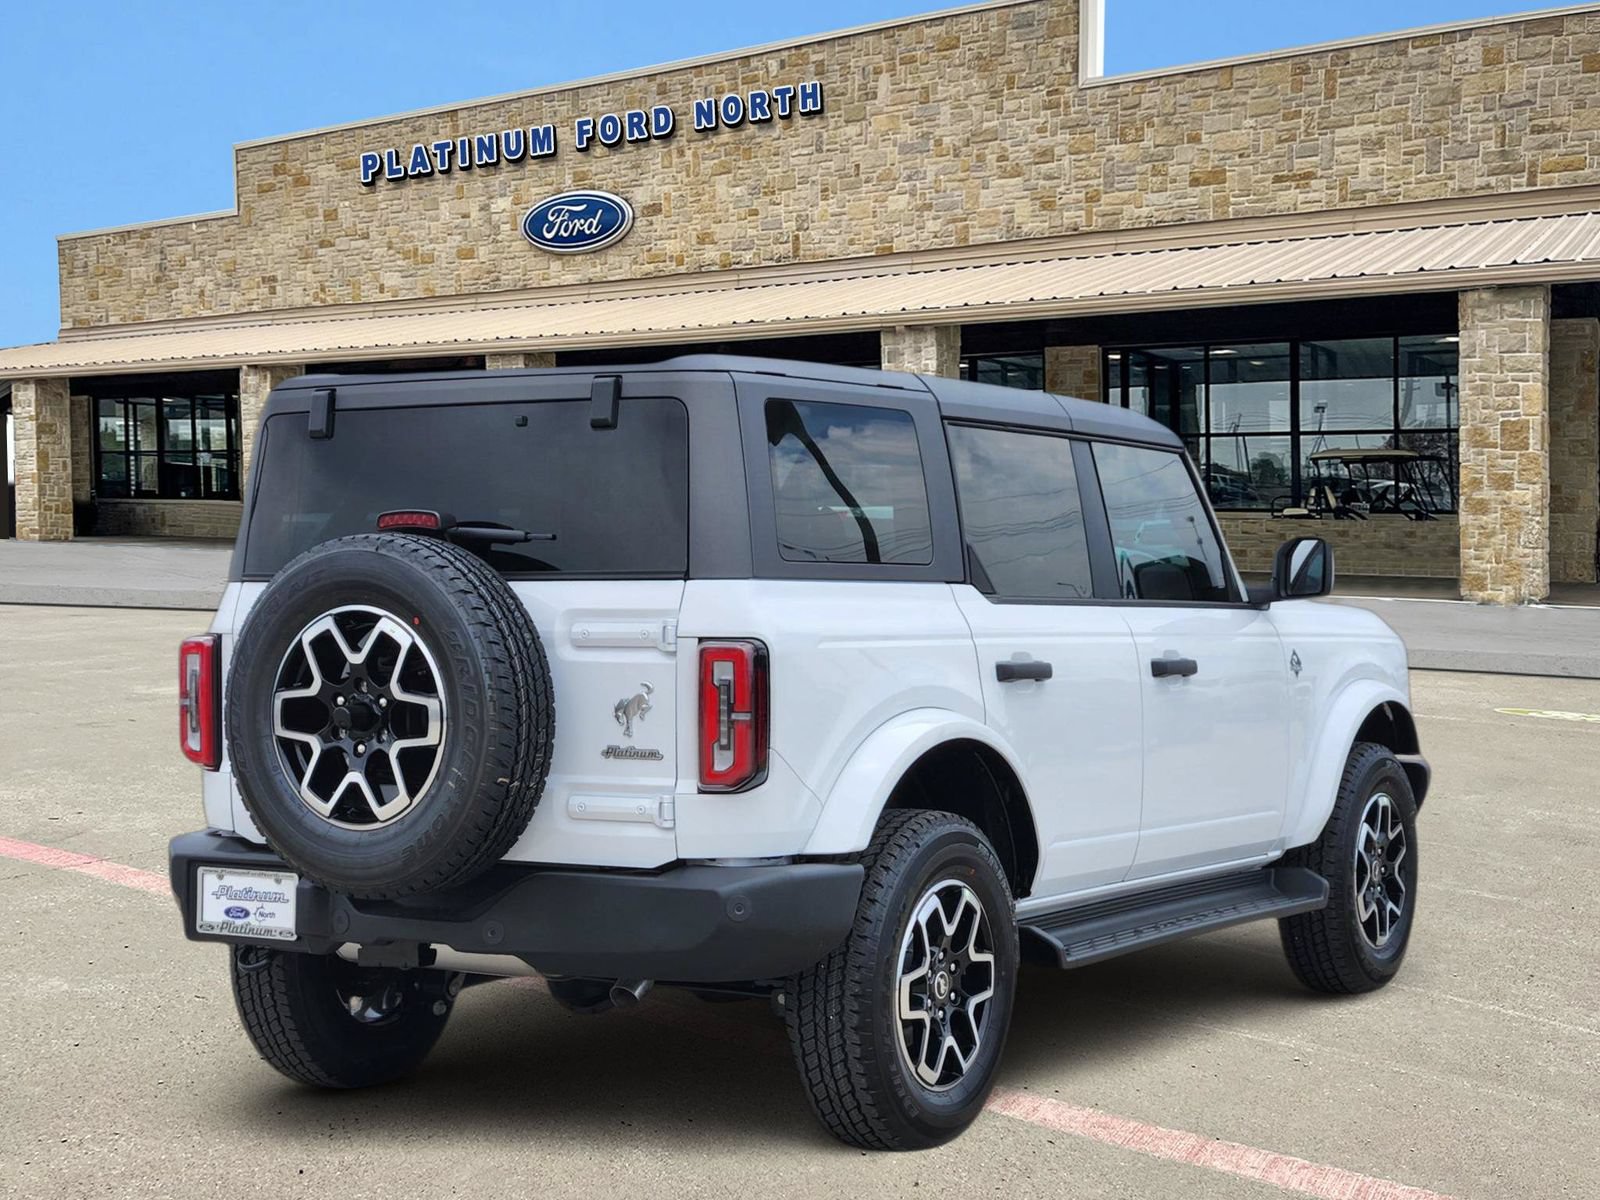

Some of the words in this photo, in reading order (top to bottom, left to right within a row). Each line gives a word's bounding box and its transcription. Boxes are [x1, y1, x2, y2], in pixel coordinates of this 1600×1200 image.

[360, 124, 556, 185] PLATINUM
[575, 105, 674, 149] FORD
[693, 81, 823, 131] NORTH
[543, 203, 603, 239] Ford
[601, 745, 664, 760] Platinum
[211, 885, 289, 903] Platinum
[258, 910, 276, 919] North
[219, 920, 277, 937] Platinum
